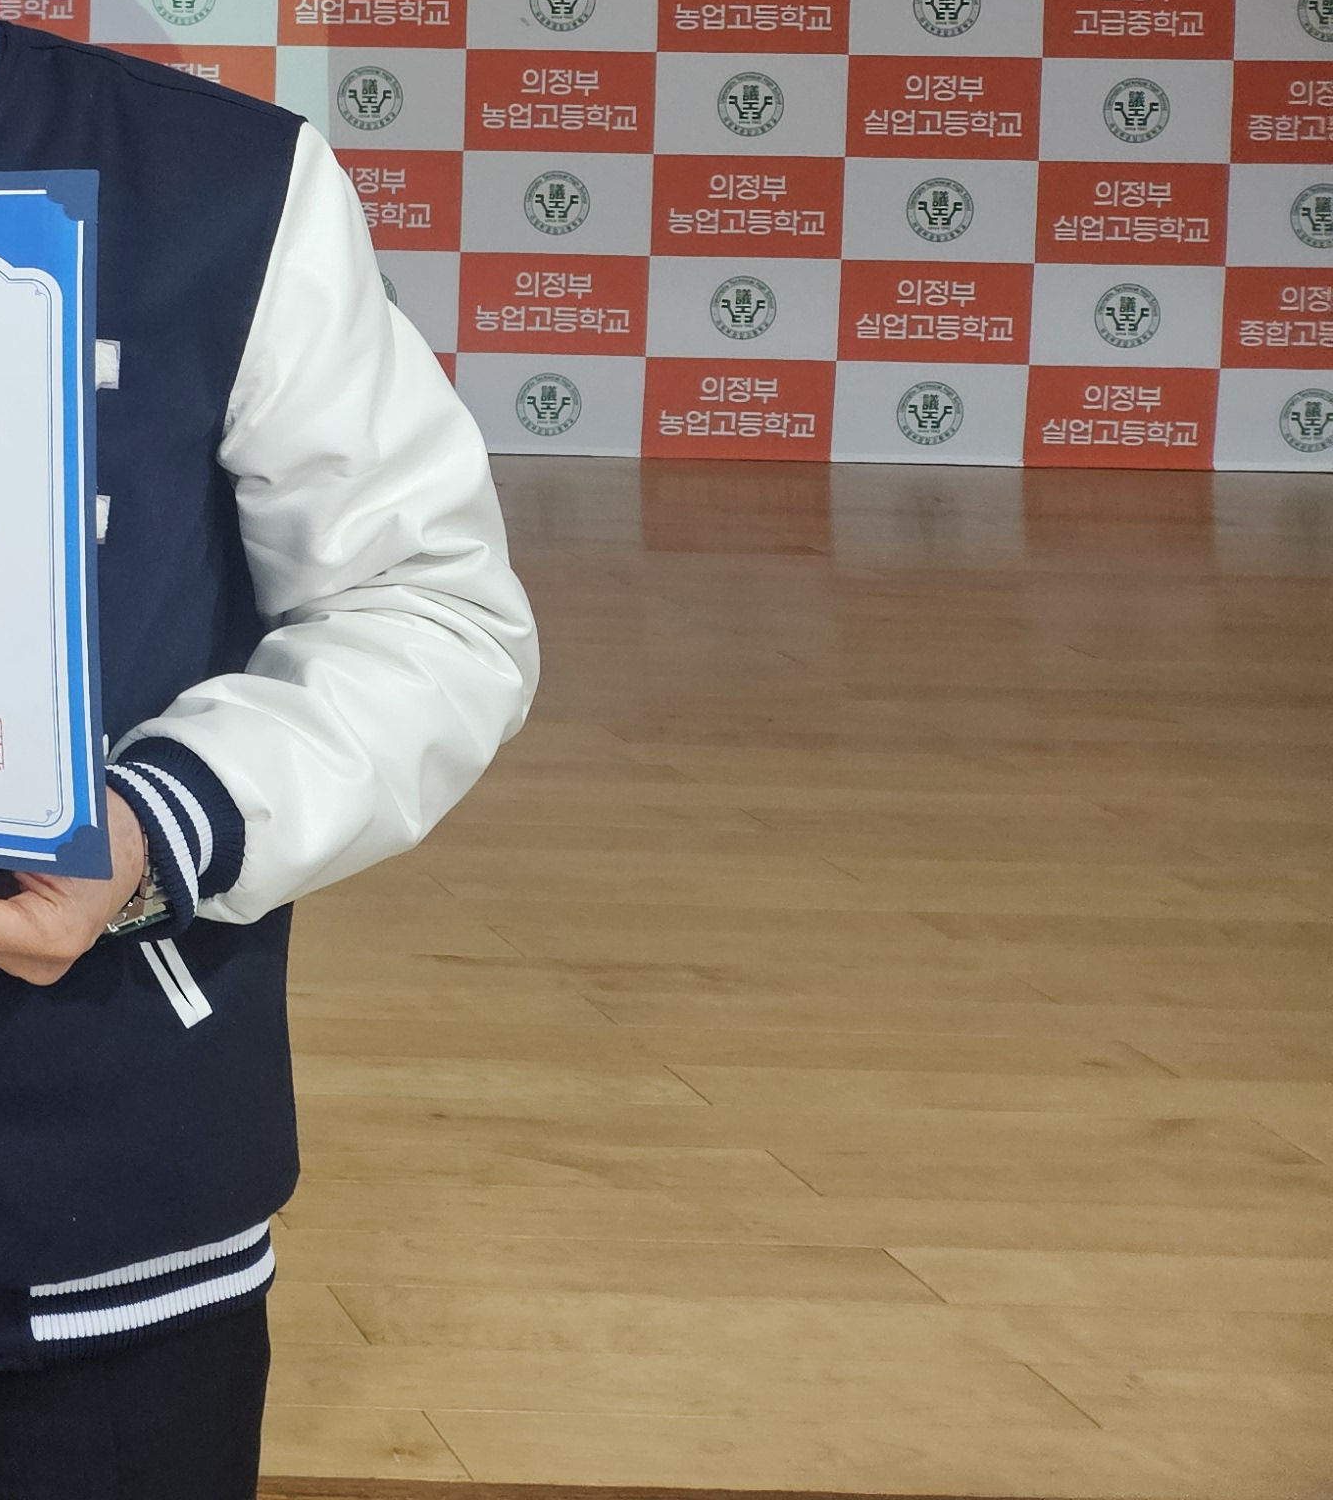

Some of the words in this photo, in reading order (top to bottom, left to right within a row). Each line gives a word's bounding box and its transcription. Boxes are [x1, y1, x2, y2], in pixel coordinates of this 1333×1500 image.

[674, 3, 833, 32] 농업고등학교
[520, 68, 600, 97] 의정부
[904, 74, 984, 102] 의정부
[481, 102, 638, 132] 농업고등학교
[863, 109, 1023, 138] 실업고등학교
[708, 173, 788, 202] 의정부
[667, 207, 825, 236] 농업고등학교
[514, 271, 593, 299] 의정부
[895, 279, 977, 307] 의정부
[474, 305, 630, 334] 농업고등학교
[855, 312, 1014, 342] 실업고등학교
[699, 376, 779, 404] 의정부
[1082, 384, 1162, 413] 의정부
[658, 409, 816, 439] 농업고등학교
[1041, 418, 1198, 447] 실업고등학교
